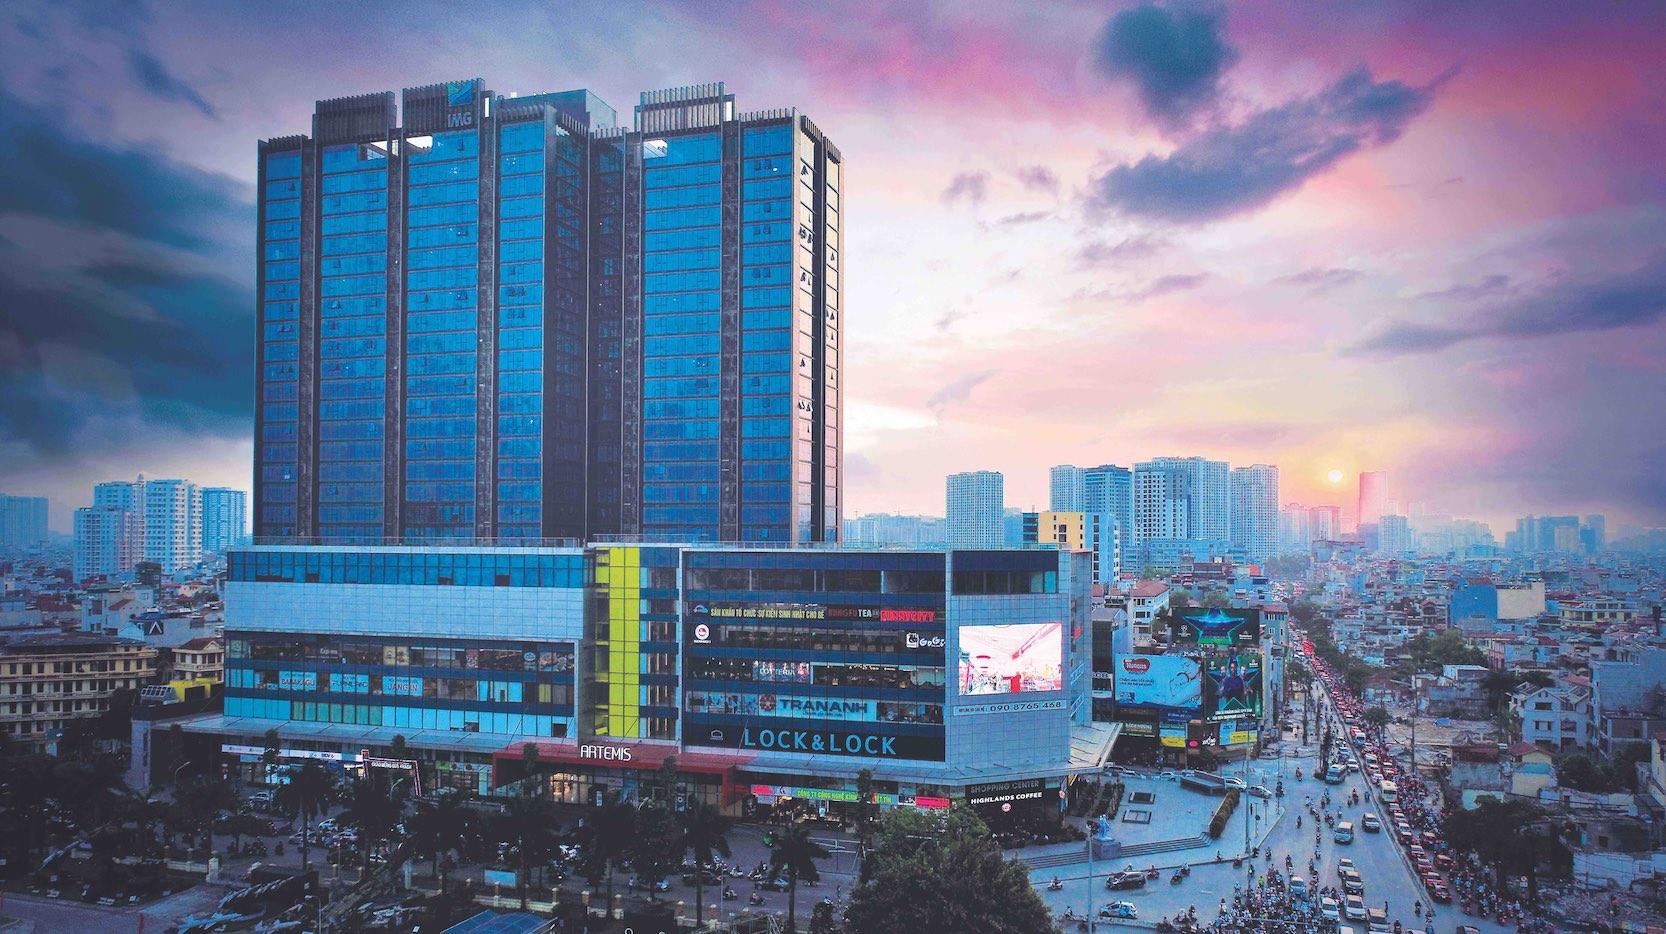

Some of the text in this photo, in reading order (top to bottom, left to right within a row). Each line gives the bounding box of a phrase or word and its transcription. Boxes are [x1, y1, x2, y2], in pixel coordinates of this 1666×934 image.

[448, 112, 472, 128] IMG
[858, 608, 872, 617] TEA
[1013, 703, 1039, 711] 8765
[1042, 701, 1061, 709] 468
[744, 728, 896, 755] LOCK&LOCK
[580, 745, 632, 761] ARTEMIS
[971, 780, 1039, 793] SHOPPING CENTER
[971, 792, 1043, 804] HIGHLANDS COFFEE
